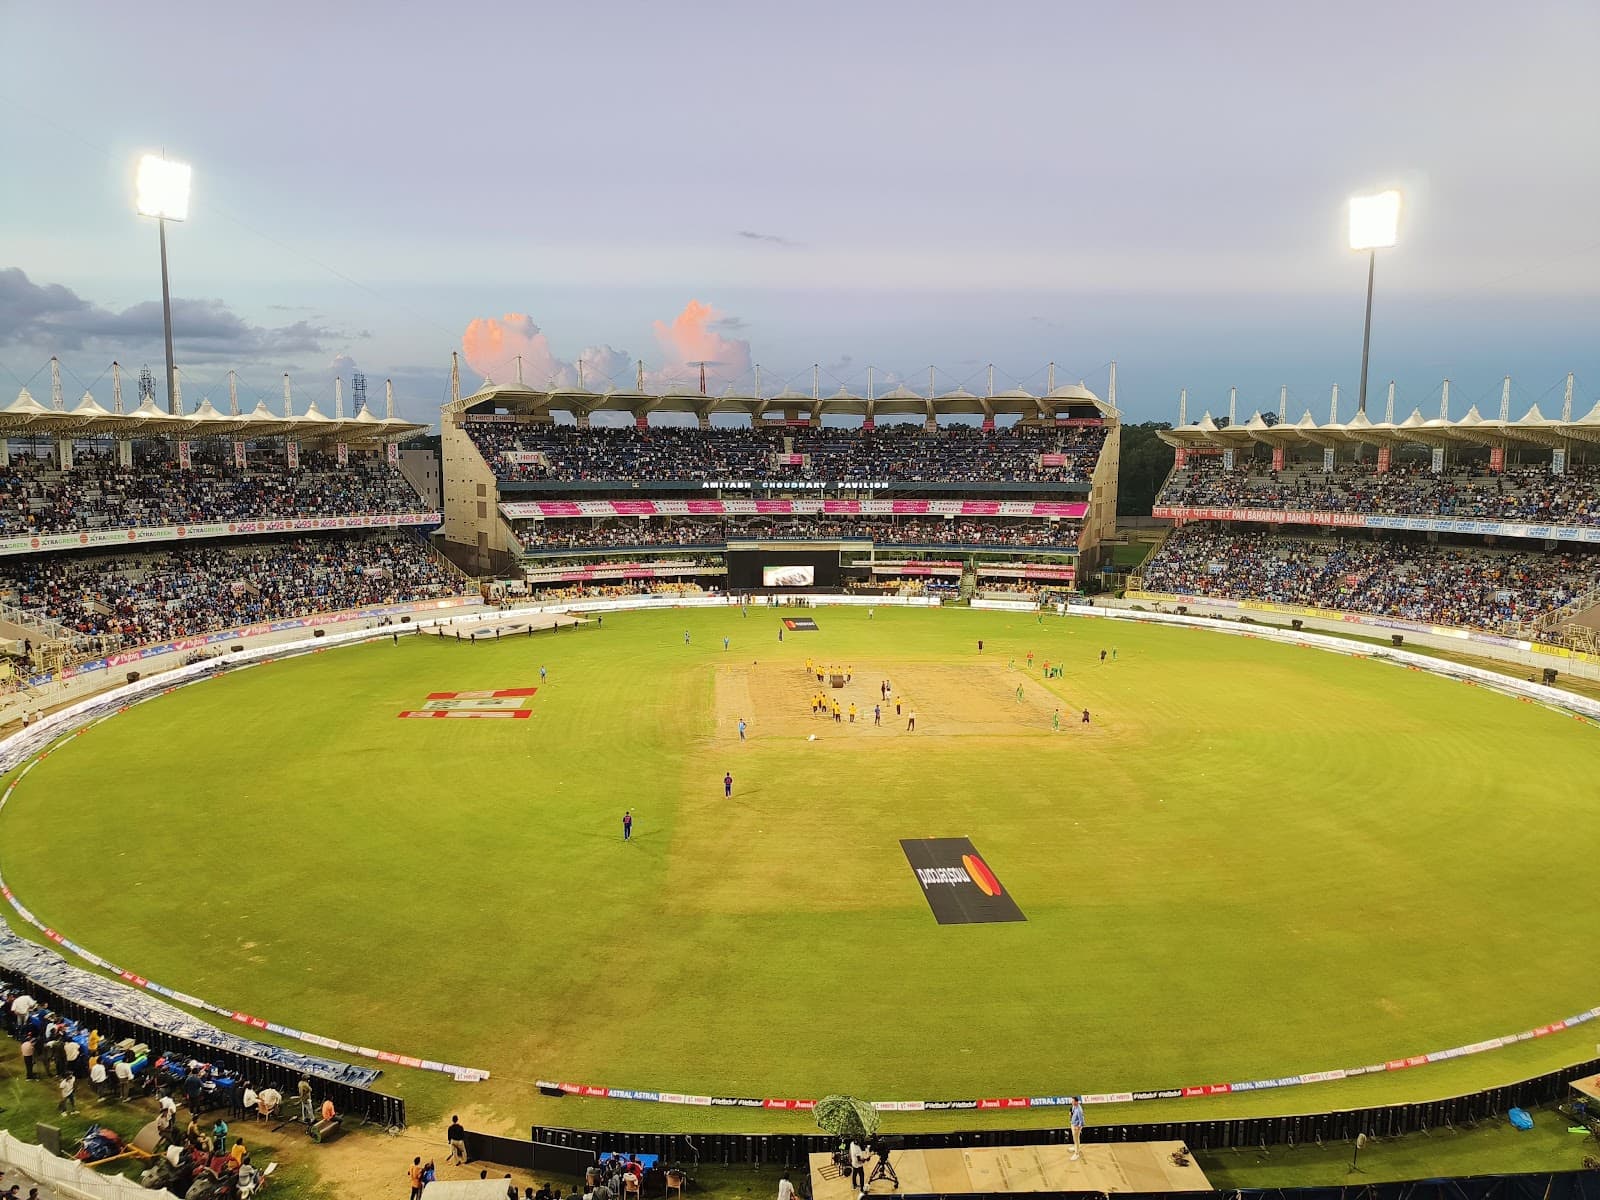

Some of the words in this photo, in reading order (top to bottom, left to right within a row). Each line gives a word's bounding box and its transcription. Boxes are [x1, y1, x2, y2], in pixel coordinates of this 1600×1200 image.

[1232, 510, 1246, 520] PAN
[1247, 510, 1271, 522] BAHAR
[1271, 511, 1285, 523] PAN
[1286, 512, 1311, 524] BAHAR
[1313, 513, 1331, 524] PAN
[1333, 514, 1365, 525] BAHAR
[915, 866, 972, 890] mastercard
[1255, 1080, 1278, 1089] ASTRAL
[1278, 1077, 1301, 1085] ASTRAL
[1231, 1083, 1255, 1092] ASTRAL
[608, 1089, 633, 1098] ASTRAL
[634, 1091, 659, 1100] ASTRAL
[1030, 1098, 1055, 1106] ASTRAL
